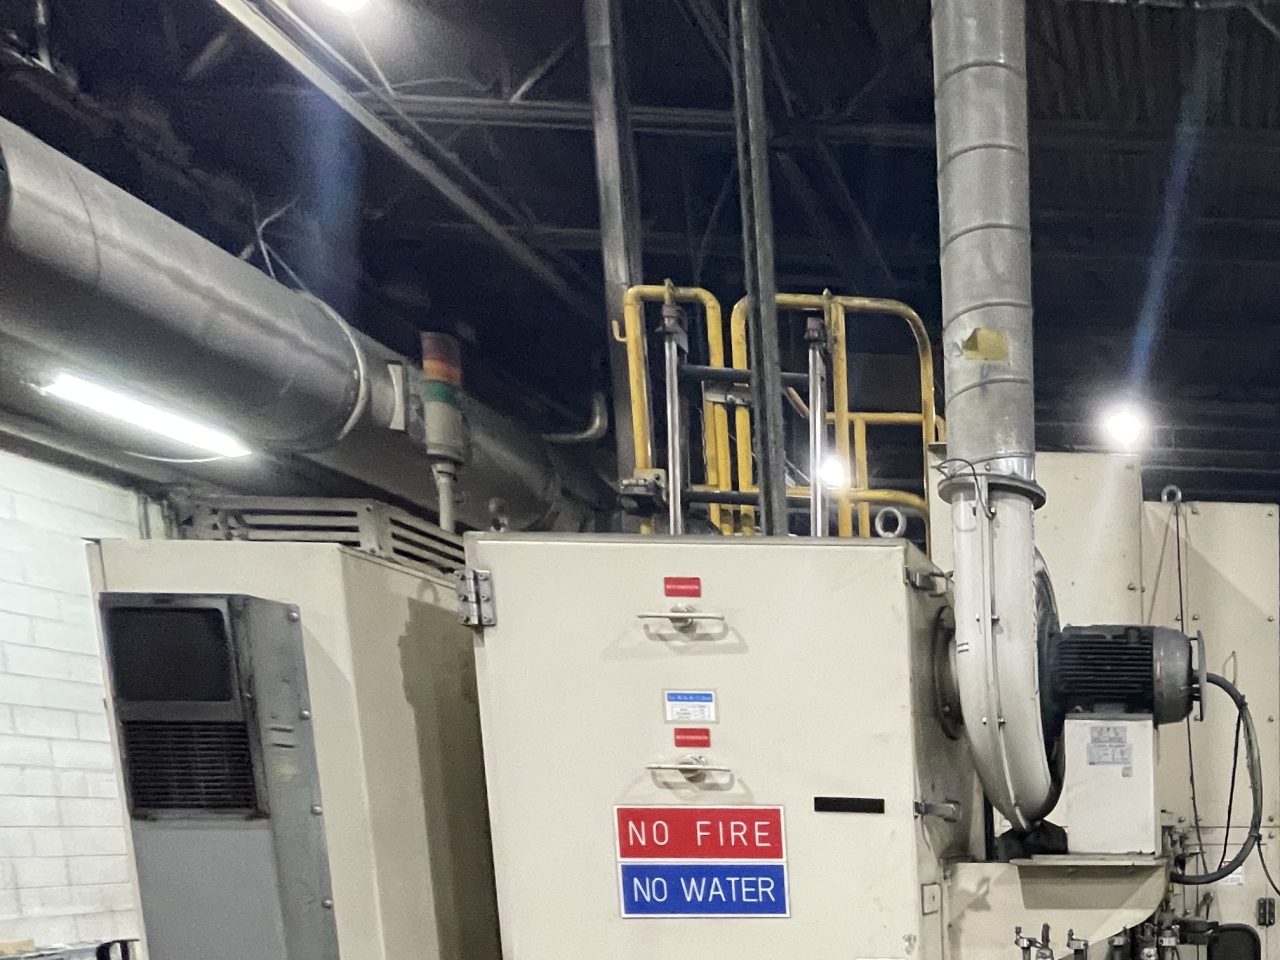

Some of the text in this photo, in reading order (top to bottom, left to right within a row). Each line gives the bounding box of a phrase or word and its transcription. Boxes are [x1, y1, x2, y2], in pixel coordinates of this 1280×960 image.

[628, 820, 772, 847] NO FIRE
[633, 877, 776, 903] NO WATER
